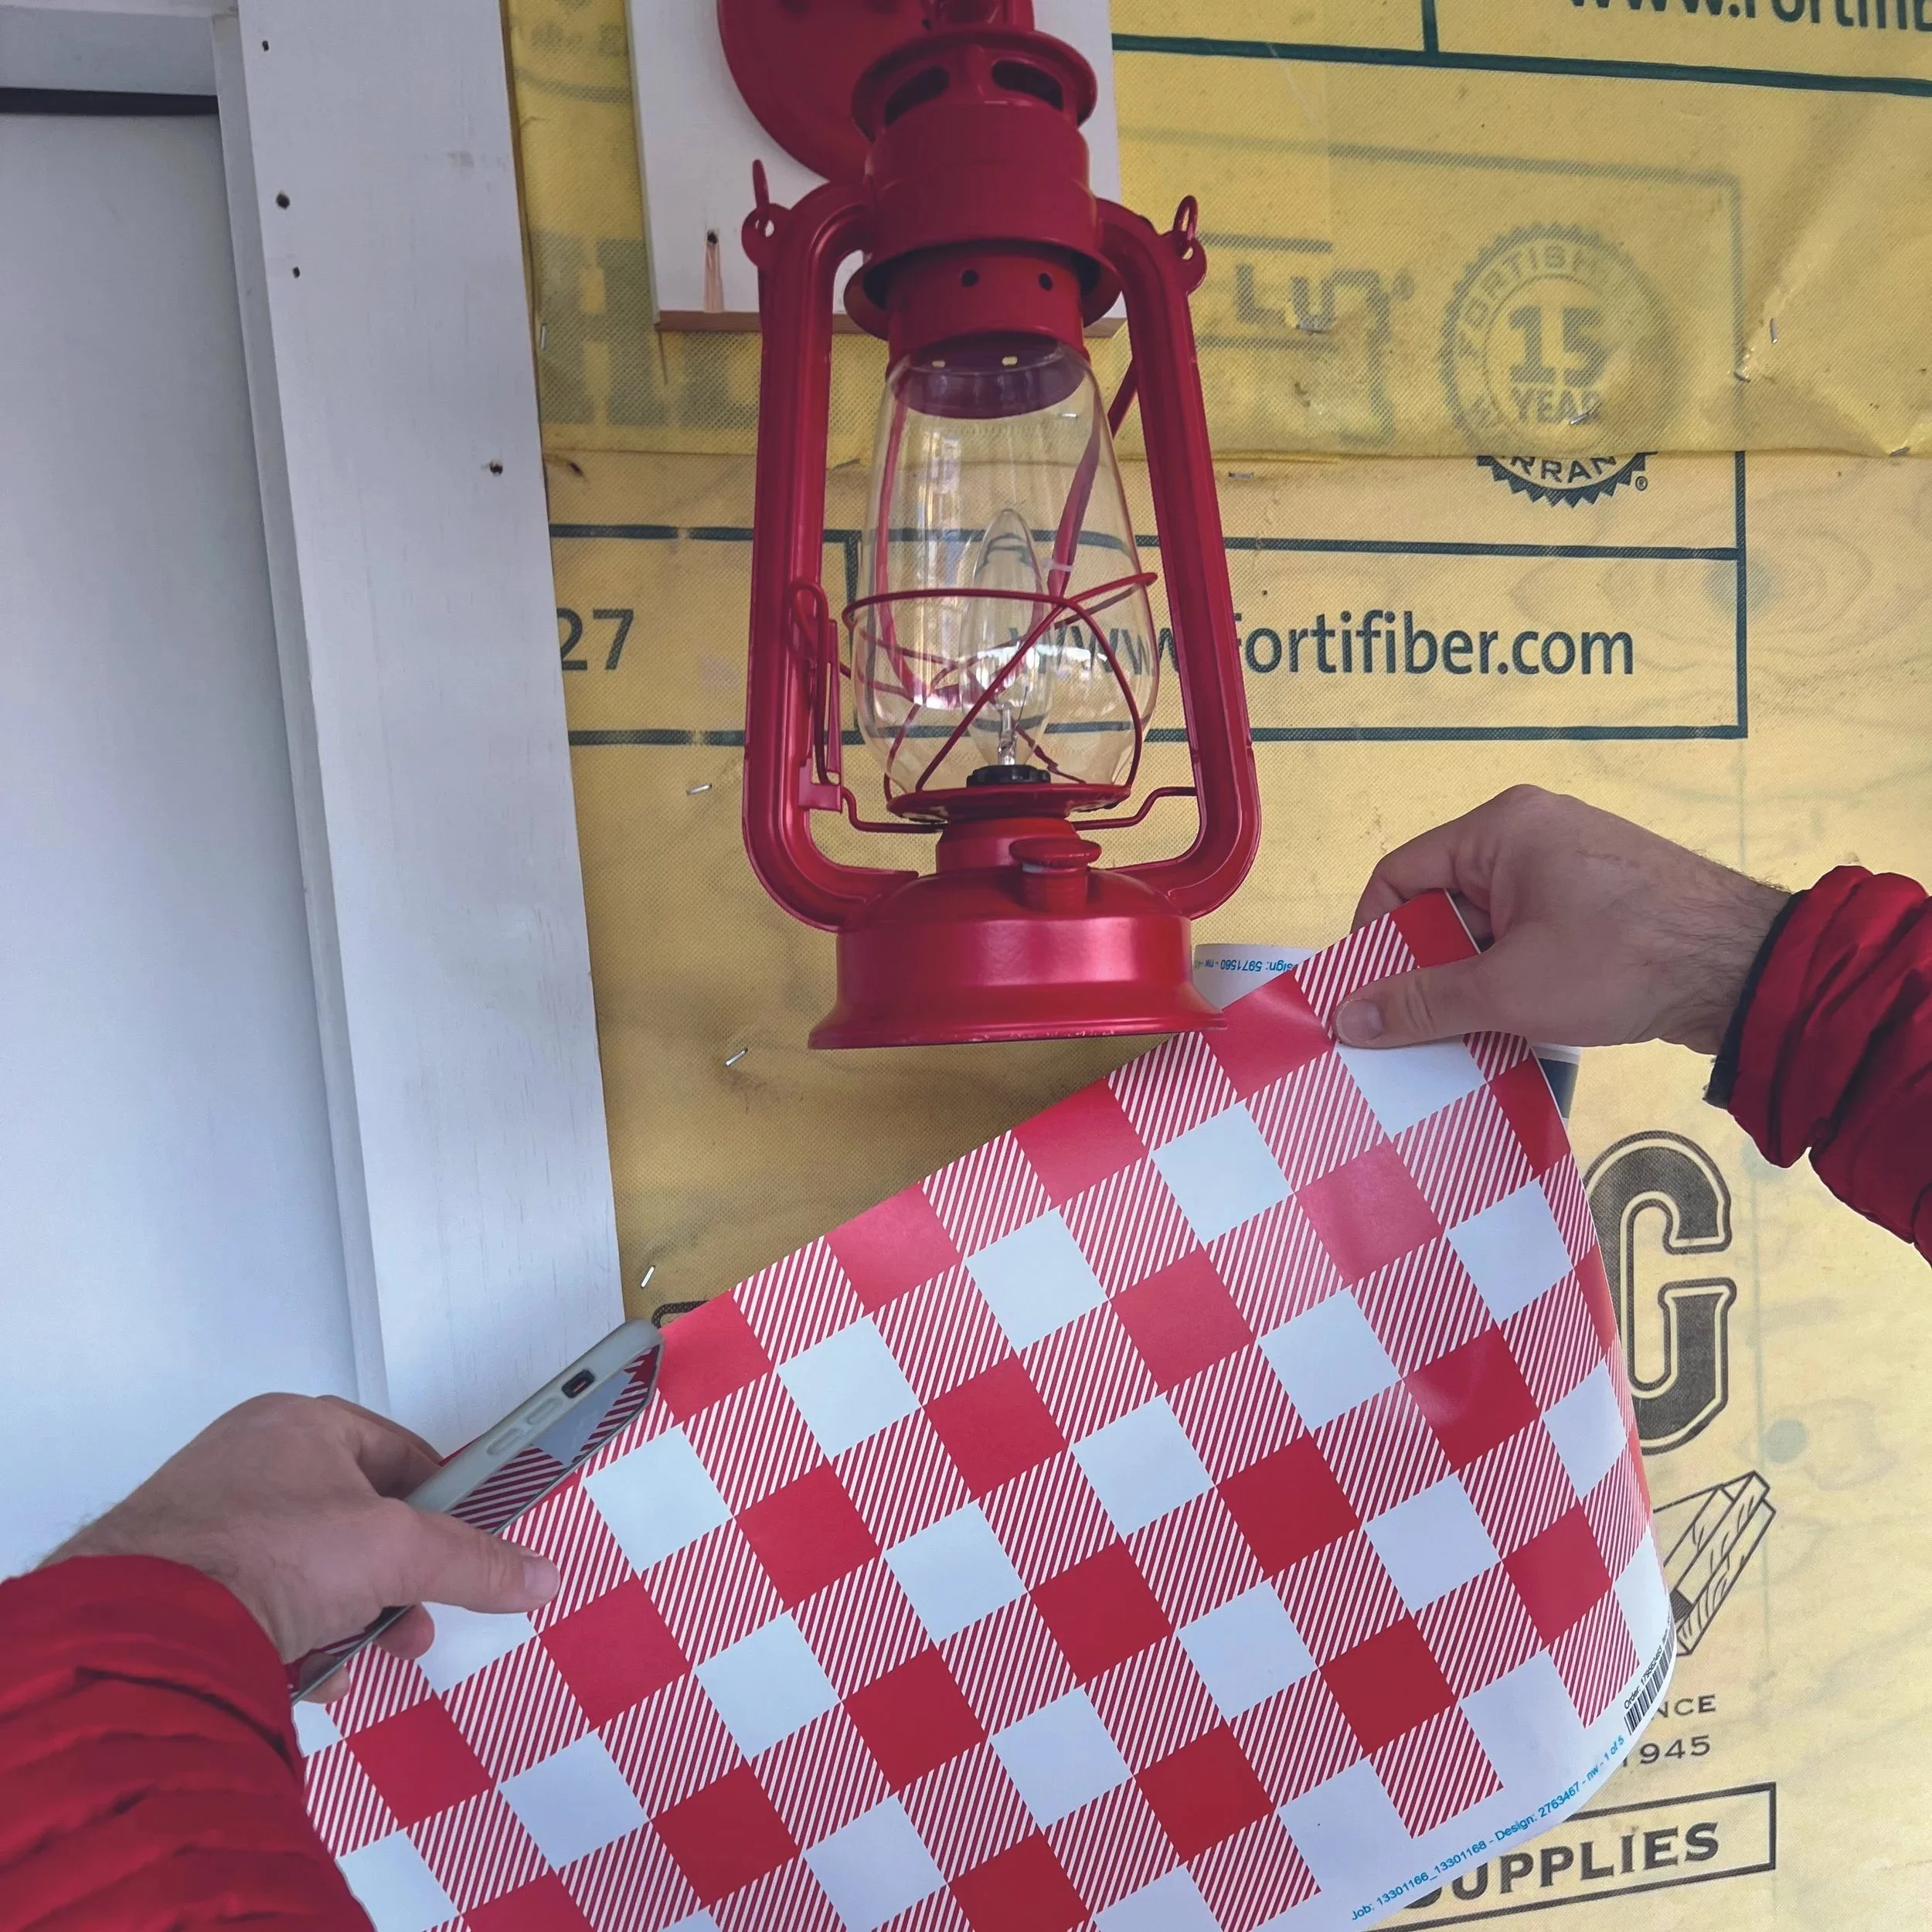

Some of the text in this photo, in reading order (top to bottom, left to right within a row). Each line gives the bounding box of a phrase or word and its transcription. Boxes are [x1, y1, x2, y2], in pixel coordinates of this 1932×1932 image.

[1509, 304, 1604, 386] 15
[556, 608, 634, 671] 27
[1624, 1685, 1641, 1709] Order:
[1656, 1693, 1716, 1718] NCE
[1352, 1903, 1375, 1920] Job:
[1376, 1840, 1487, 1906] 13301166_13301168
[1495, 1813, 1538, 1842] Design:
[1538, 1781, 1580, 1818] 2763467
